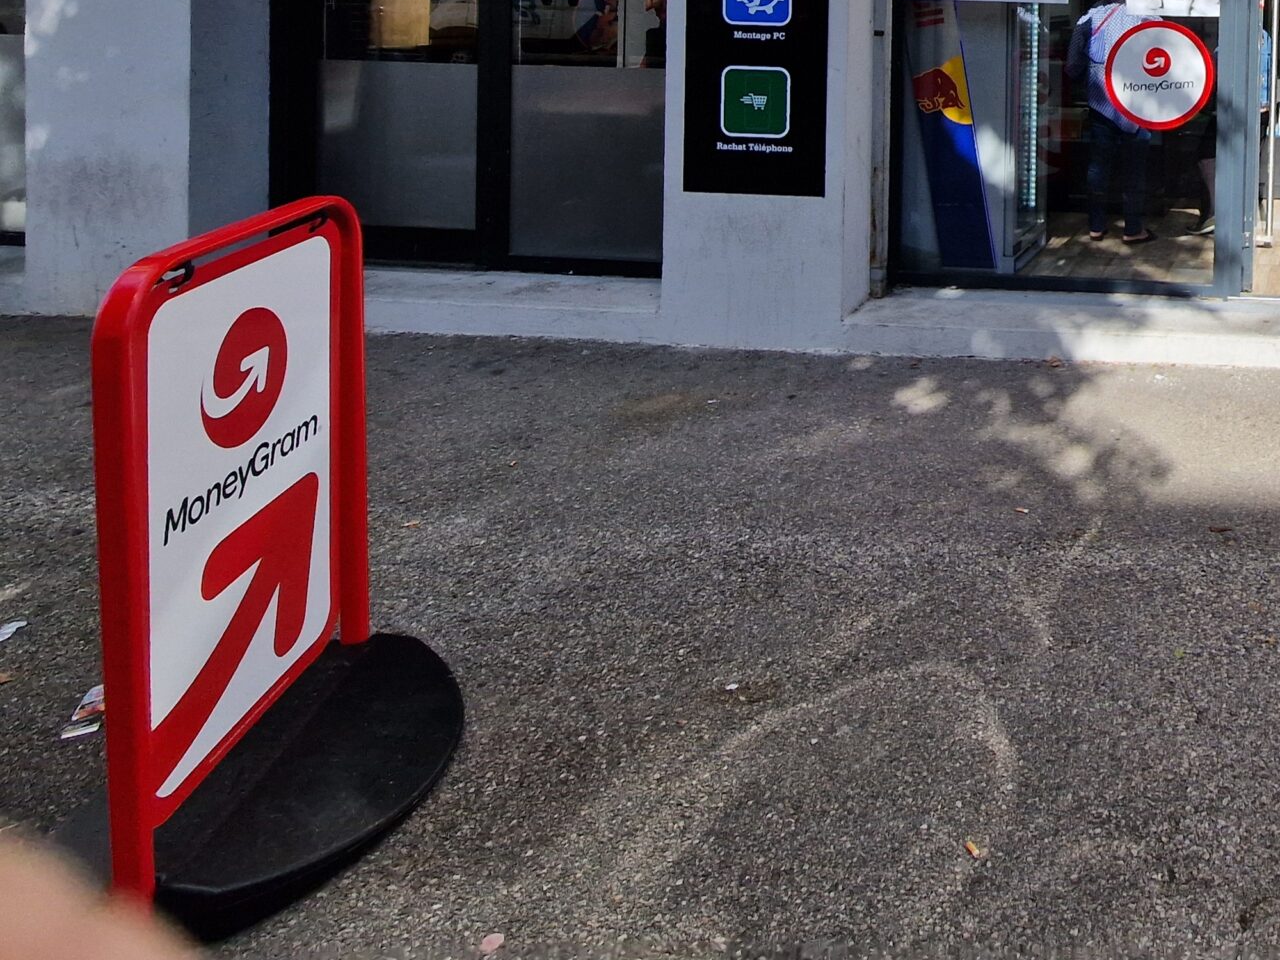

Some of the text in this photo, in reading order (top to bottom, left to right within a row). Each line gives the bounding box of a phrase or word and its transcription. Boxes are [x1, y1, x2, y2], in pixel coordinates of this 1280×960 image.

[733, 31, 785, 40] Montage PC
[1123, 80, 1194, 93] MoneyGram
[716, 142, 793, 153] Rachat Téléphone
[163, 414, 319, 546] MoneyGram
